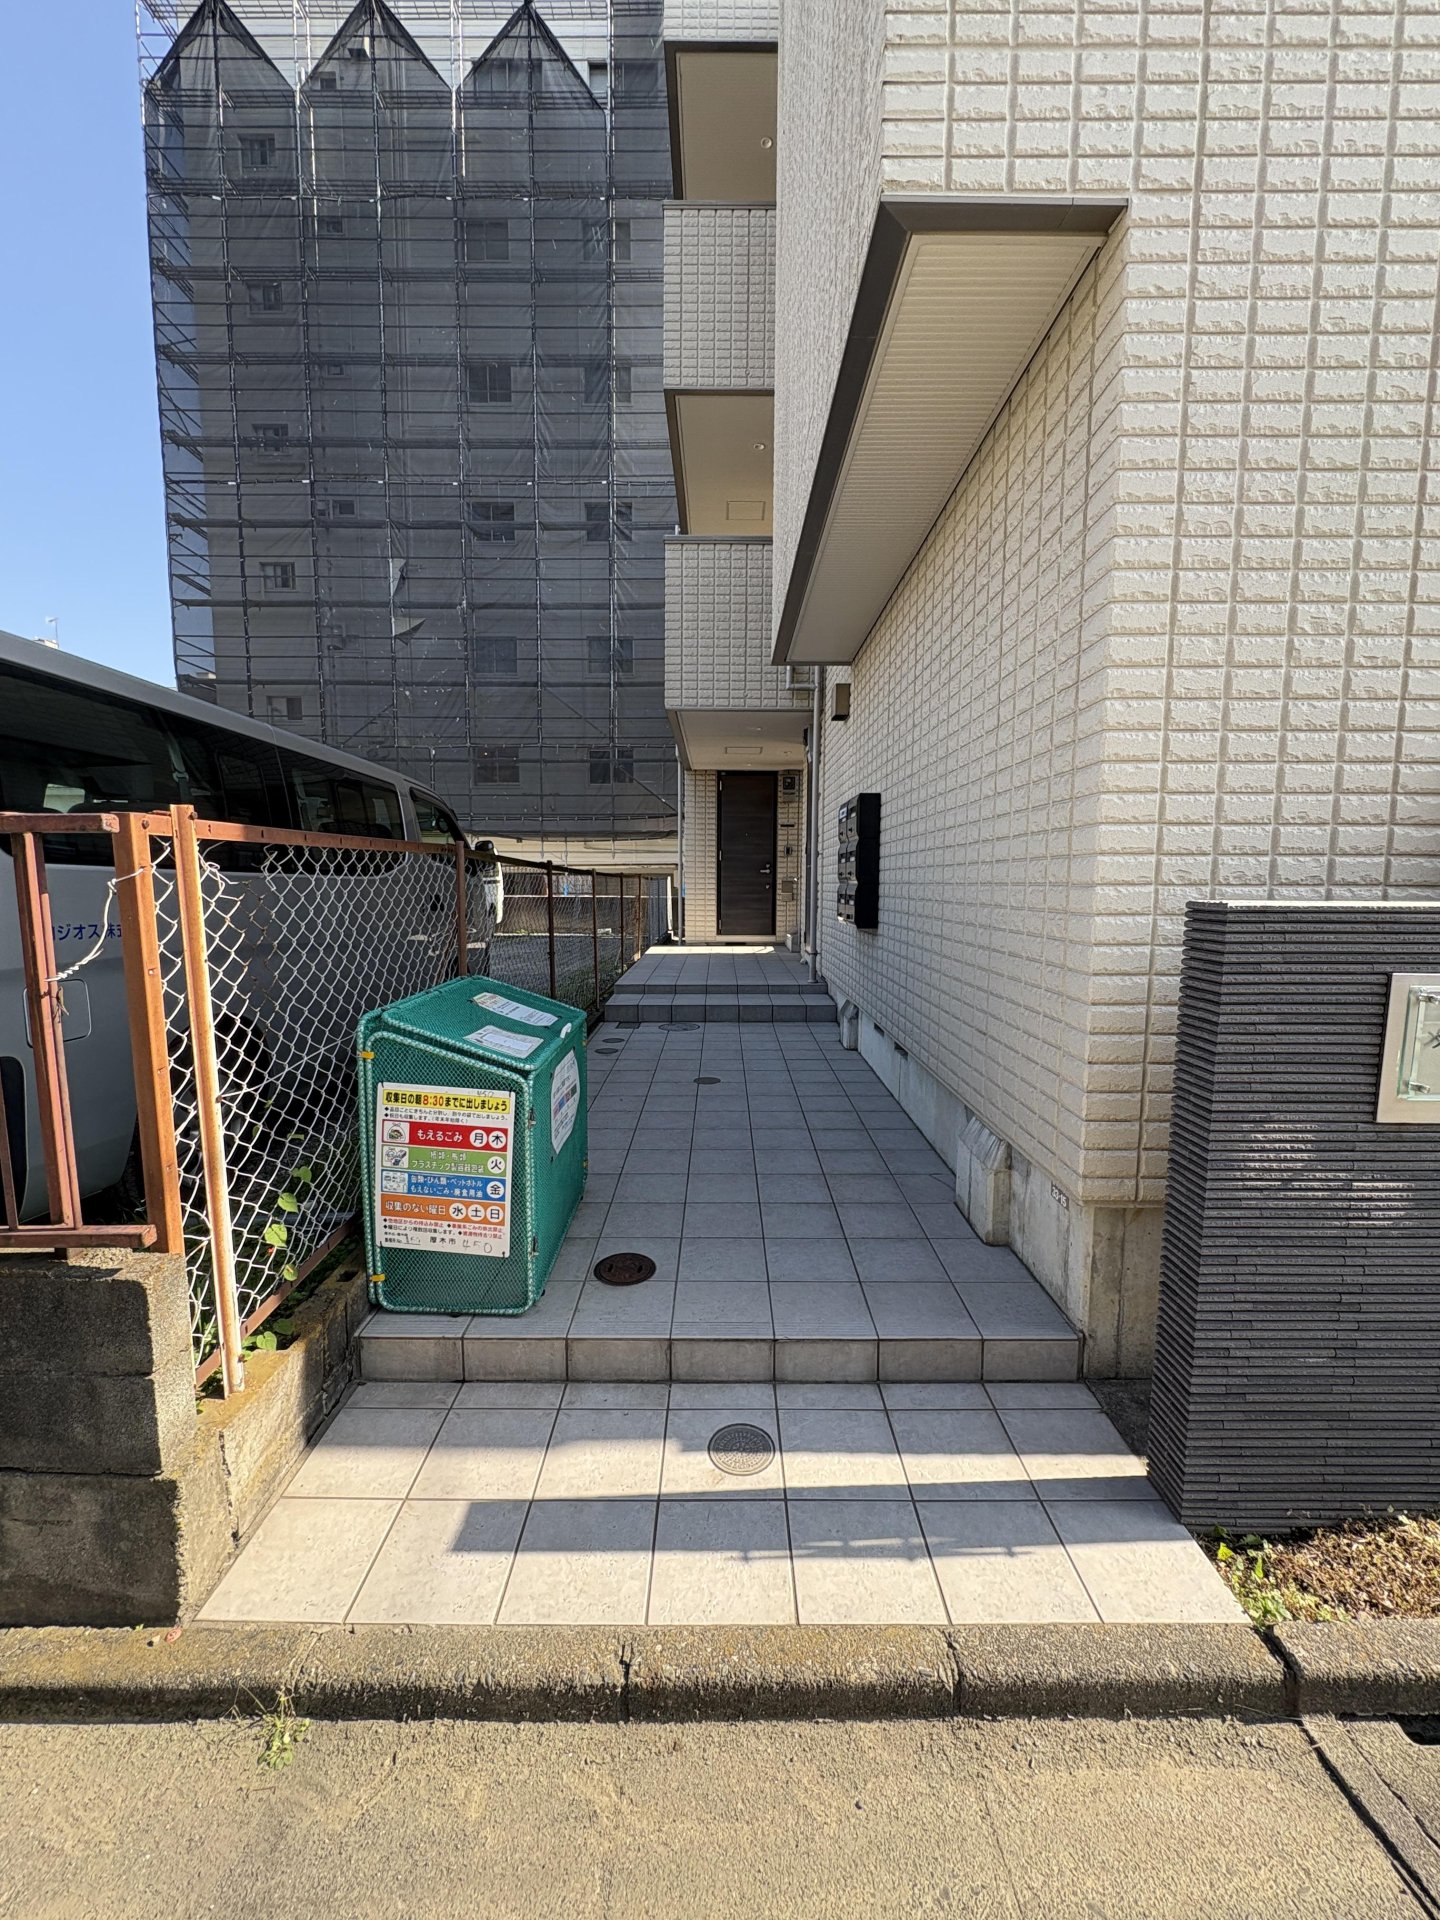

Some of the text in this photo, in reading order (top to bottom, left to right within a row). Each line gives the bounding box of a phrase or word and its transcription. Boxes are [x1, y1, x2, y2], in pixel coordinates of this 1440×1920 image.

[417, 1129, 503, 1145] もえるごみ 月 木
[490, 1159, 502, 1171] 火
[489, 1184, 501, 1195] 金
[385, 1201, 500, 1219] 収集のない曜日 水 土 日
